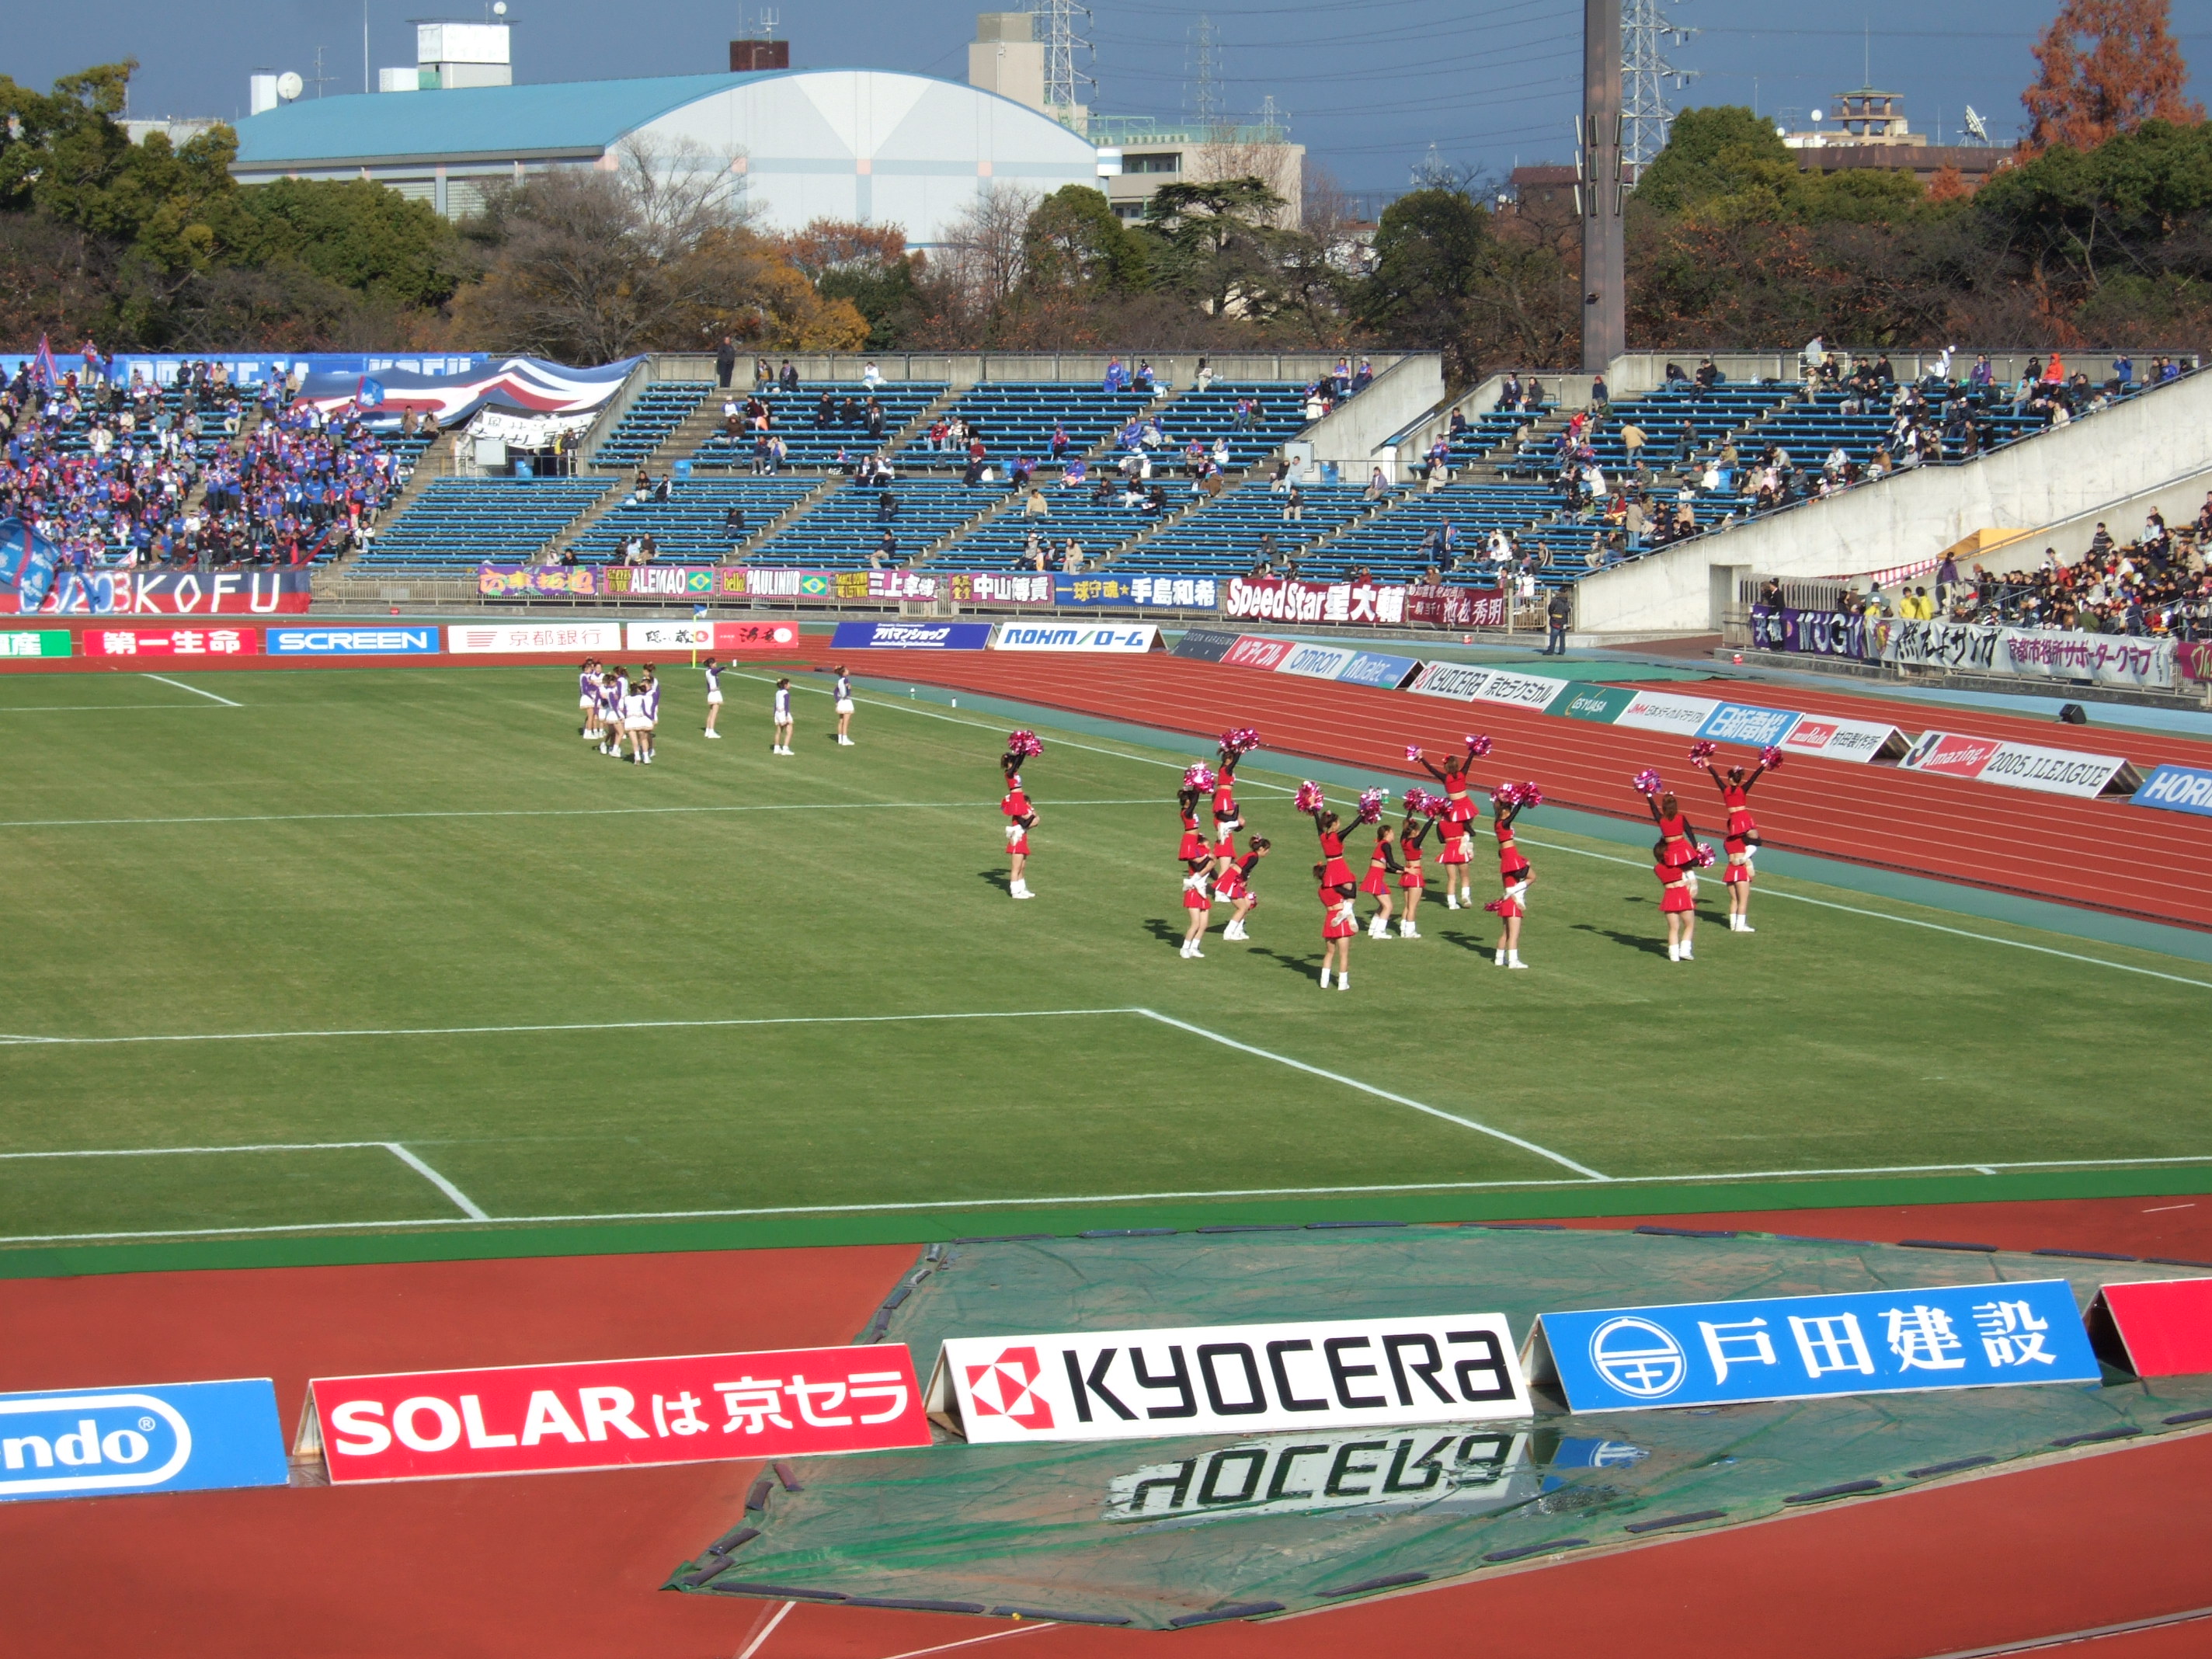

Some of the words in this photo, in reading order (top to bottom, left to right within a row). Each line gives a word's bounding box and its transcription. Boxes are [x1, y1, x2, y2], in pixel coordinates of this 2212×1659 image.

[134, 572, 281, 613] KOFU
[746, 569, 800, 596] PAULINHO
[103, 630, 241, 655] 第一生命
[278, 631, 427, 650] SCREEN
[509, 629, 602, 646] 京都銀行
[872, 627, 951, 641] アパマンショップ
[1895, 621, 2002, 668] 燃えよサンガ
[1240, 641, 1285, 666] アイフル
[2007, 637, 2157, 676] 京都市役所サポータークラブ
[1484, 676, 1553, 704] 京セラケミカル
[1830, 730, 1881, 750] 村田製作所
[1987, 751, 2033, 775] 2005
[2022, 756, 2111, 788] J.LEAGUE
[2144, 772, 2212, 808] HORI
[1697, 1299, 2057, 1387] 戸田建設
